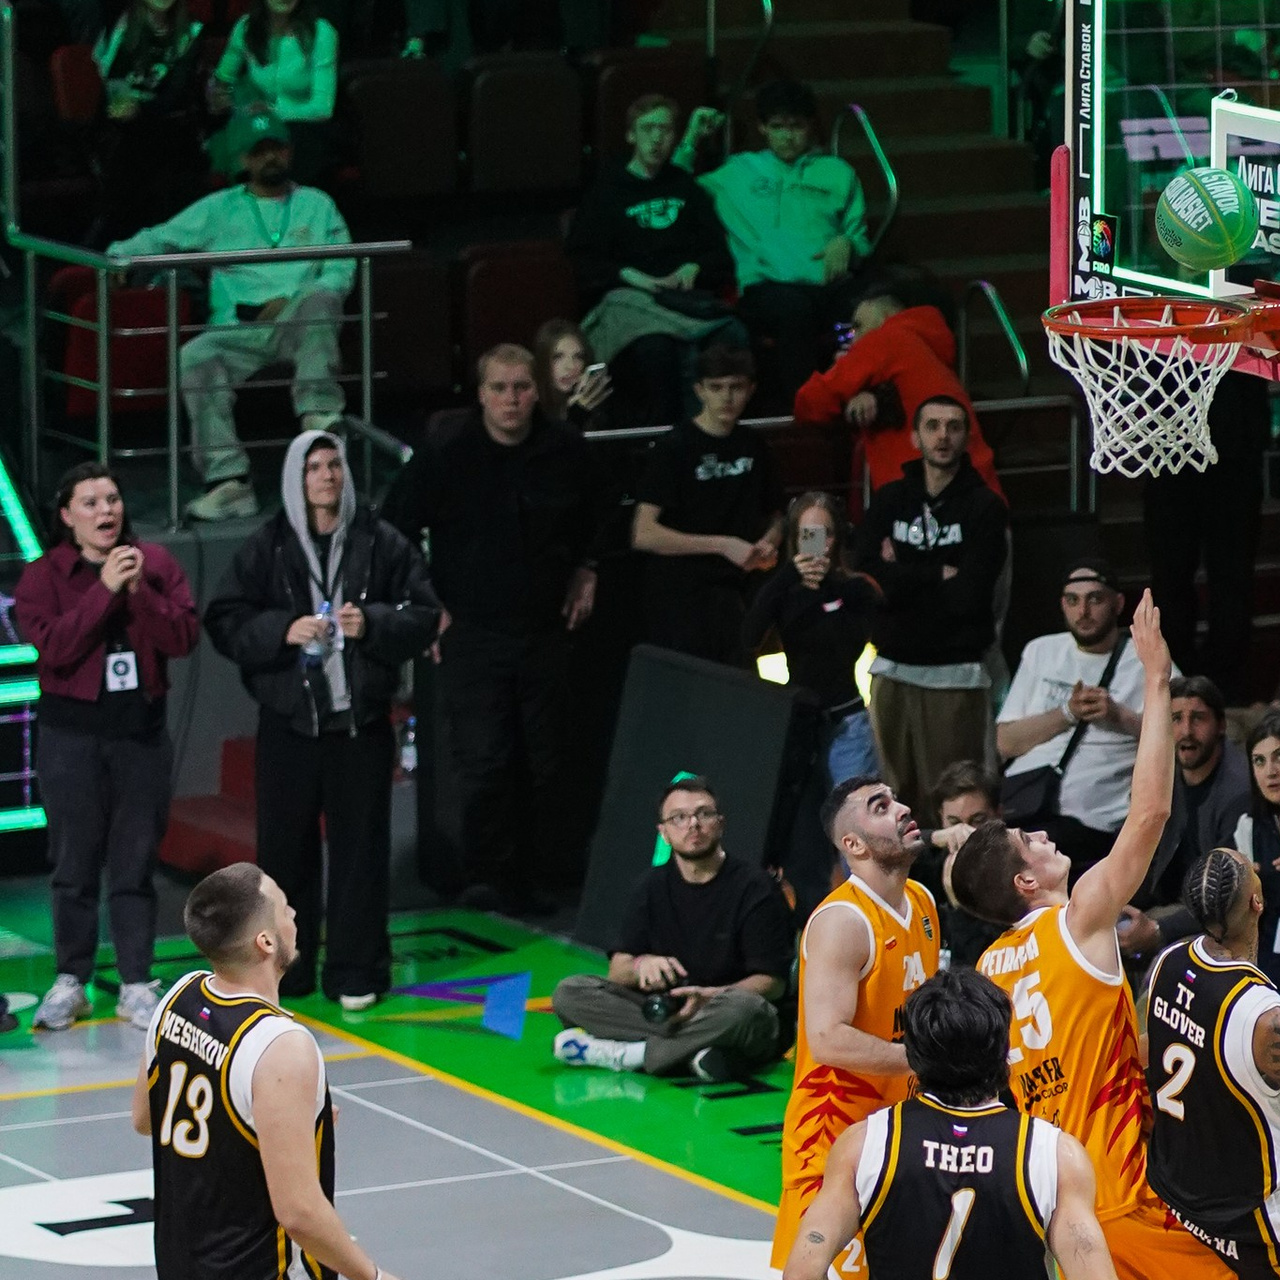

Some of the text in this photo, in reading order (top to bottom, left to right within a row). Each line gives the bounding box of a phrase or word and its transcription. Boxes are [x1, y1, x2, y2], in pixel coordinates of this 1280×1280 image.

[1153, 996, 1206, 1048] GLOVER
[1176, 982, 1196, 1011] TY
[160, 1010, 229, 1071] MESHKOV
[1156, 1042, 1197, 1122] 2
[160, 1060, 213, 1159] 13
[923, 1139, 994, 1173] THEO
[841, 1237, 867, 1272] 2
